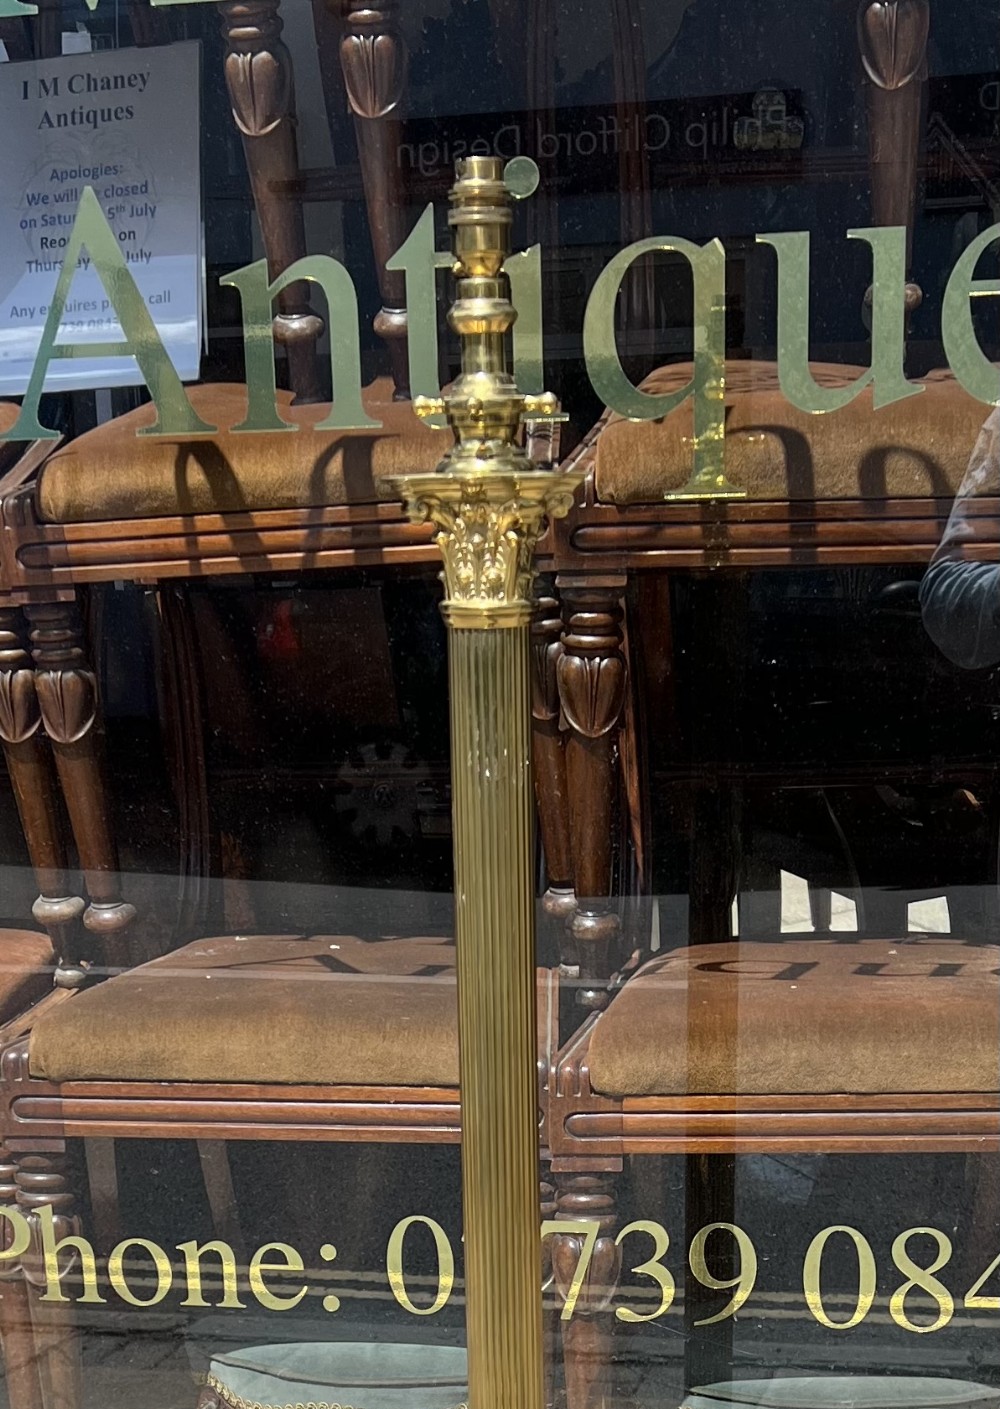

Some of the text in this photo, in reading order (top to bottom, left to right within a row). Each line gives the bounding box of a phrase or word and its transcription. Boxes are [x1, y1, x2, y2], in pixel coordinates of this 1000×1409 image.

[22, 71, 151, 100] I M Chaney
[38, 105, 135, 129] Antiques
[50, 163, 124, 183] Apologies:
[26, 191, 49, 207] We
[53, 187, 78, 203] will
[104, 180, 148, 199] closed
[20, 217, 37, 230] on
[129, 203, 157, 219] July
[118, 229, 136, 242] on
[26, 249, 152, 274] Thursay July
[10, 304, 36, 319] Any
[39, 299, 97, 316] euires
[148, 290, 171, 305] call
[386, 1214, 758, 1327] 0739
